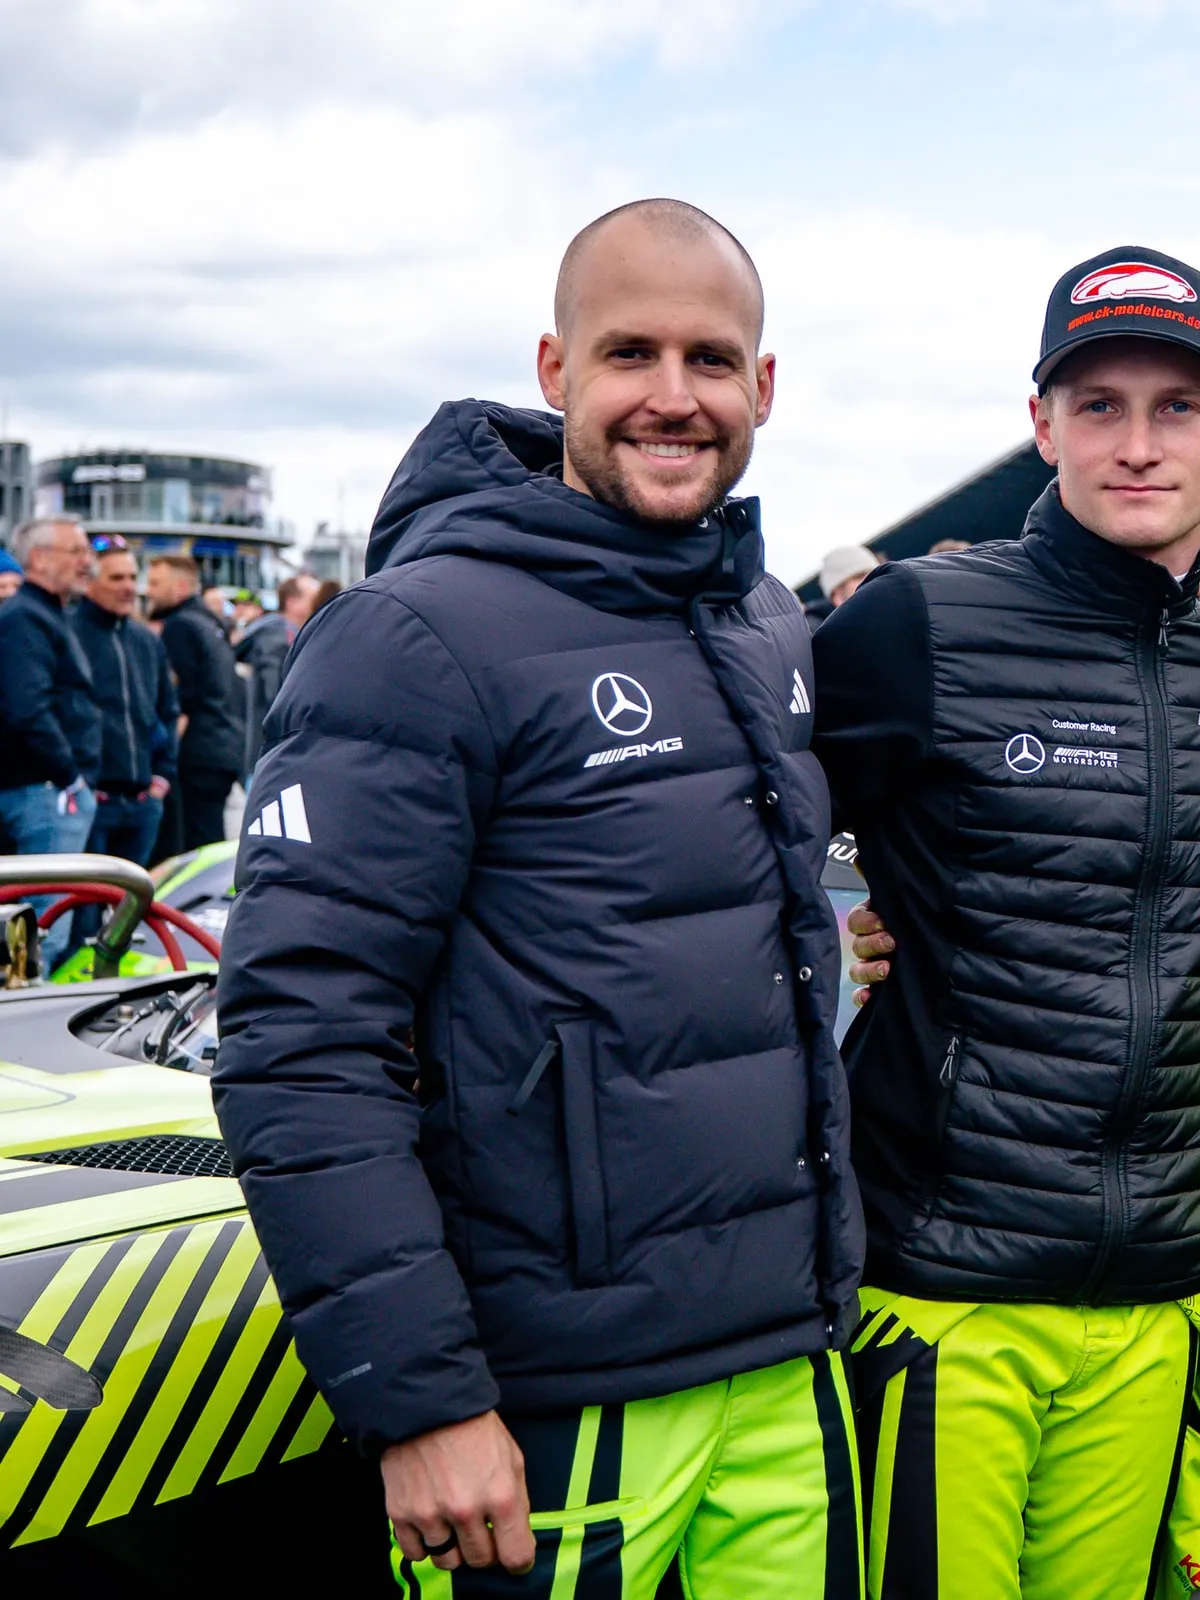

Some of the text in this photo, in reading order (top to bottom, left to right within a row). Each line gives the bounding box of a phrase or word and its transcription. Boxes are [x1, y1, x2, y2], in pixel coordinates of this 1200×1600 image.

[1052, 719, 1117, 735] Customer Racing
[1052, 755, 1119, 768] MOTORSPORT
